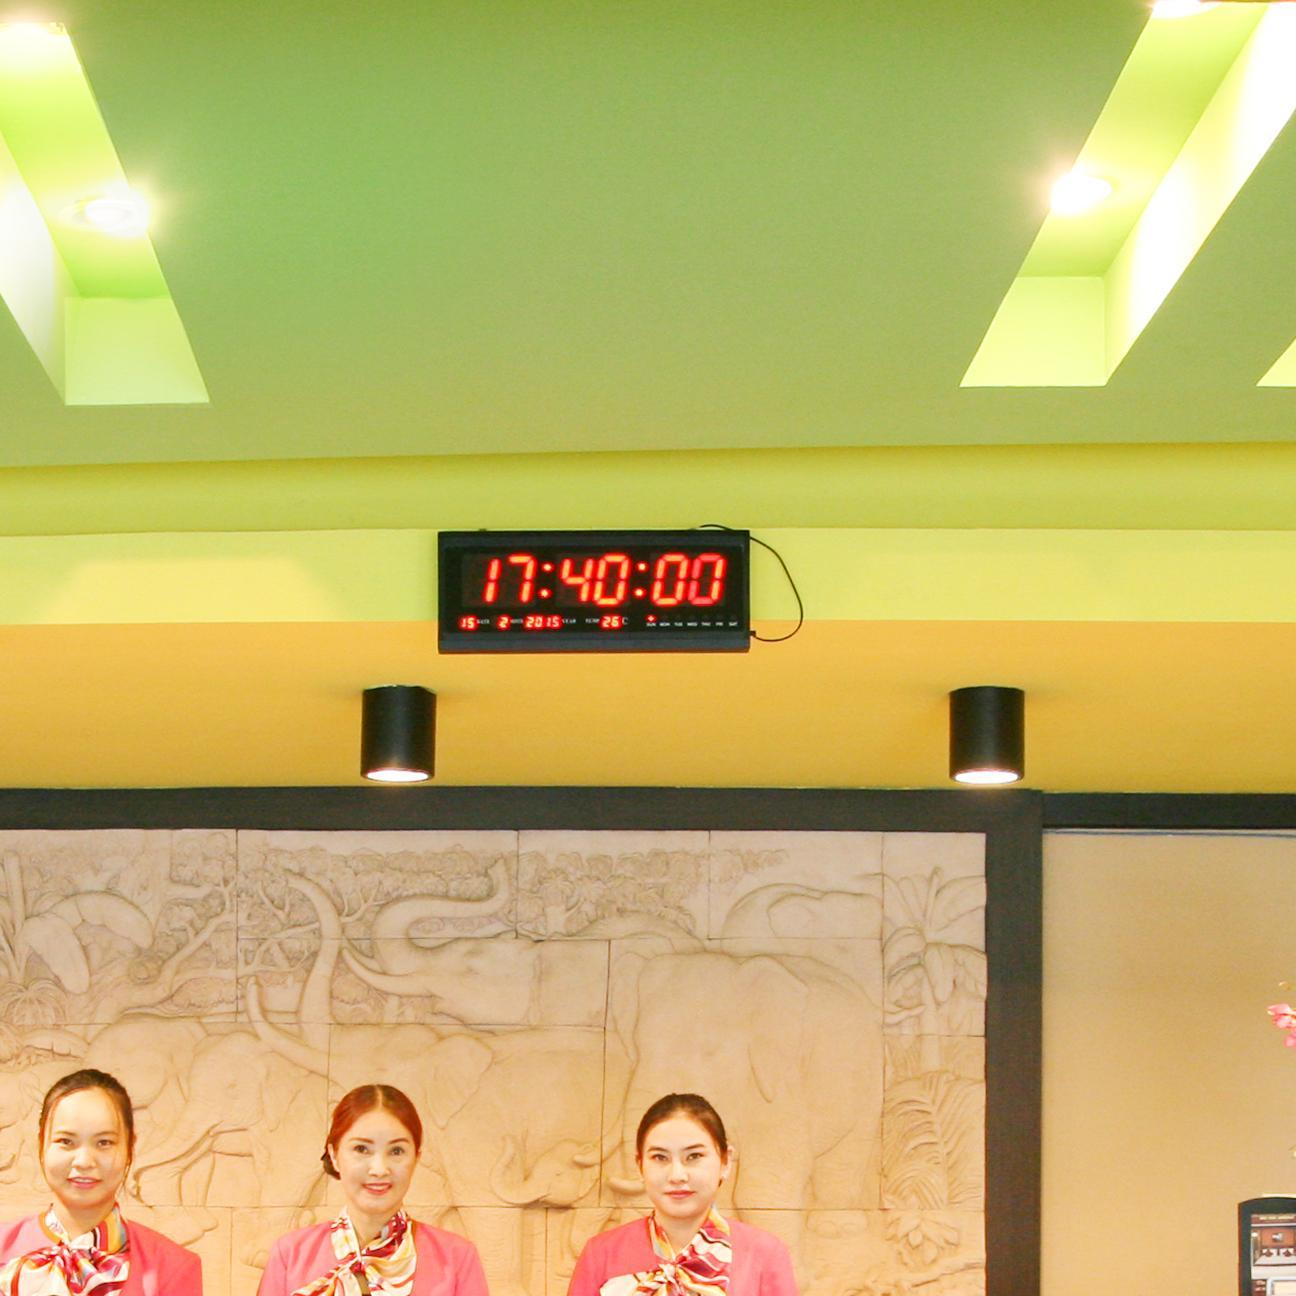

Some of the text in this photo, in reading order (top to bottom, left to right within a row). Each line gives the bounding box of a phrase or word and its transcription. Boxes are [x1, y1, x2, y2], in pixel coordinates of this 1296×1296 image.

[482, 553, 726, 606] 17:40:00
[460, 616, 476, 630] 15
[498, 616, 509, 629] 2
[525, 616, 561, 629] 2015
[602, 616, 620, 629] 26
